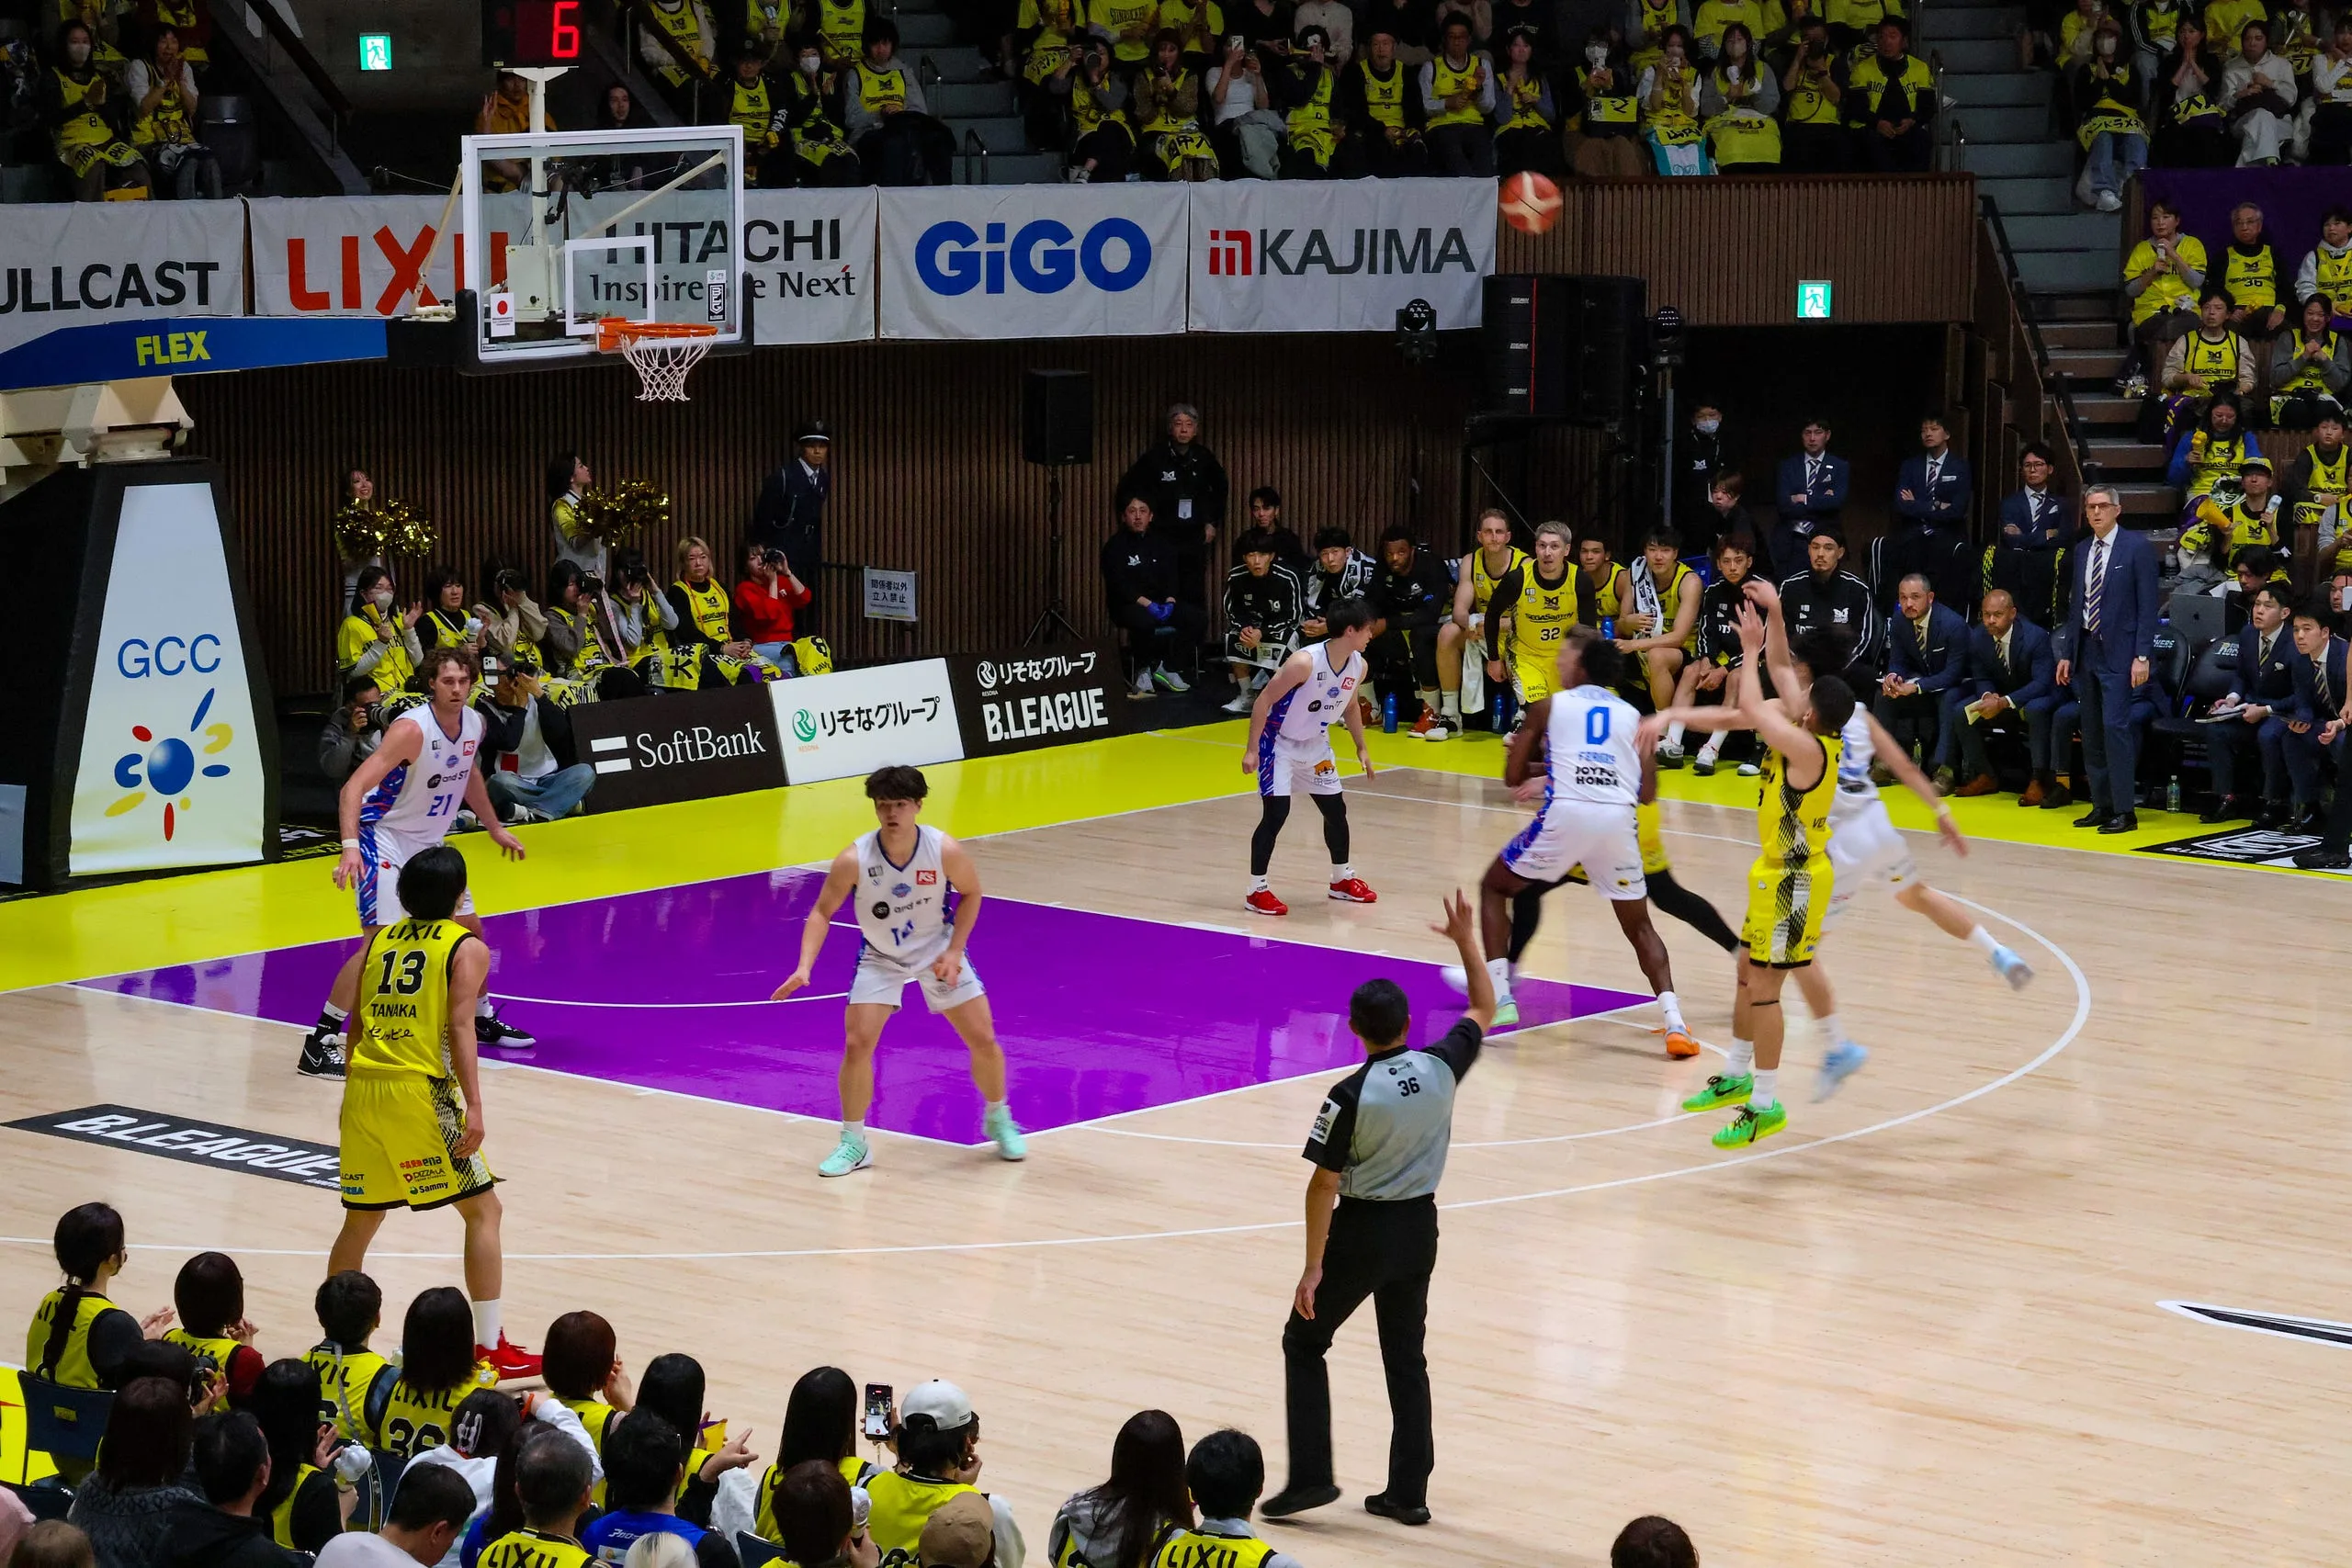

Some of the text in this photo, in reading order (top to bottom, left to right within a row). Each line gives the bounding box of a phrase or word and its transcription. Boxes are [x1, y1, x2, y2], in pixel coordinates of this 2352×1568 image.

[552, 1, 579, 58] 6
[605, 219, 840, 265] HITACHI
[915, 218, 1152, 296] GiGO
[1260, 228, 1476, 275] KAJIMA
[589, 273, 704, 309] Inspire
[776, 266, 856, 299] Next
[136, 331, 211, 367] FLEX
[873, 592, 906, 604] 立入禁止
[1540, 627, 1560, 641] 32
[118, 634, 221, 679] GCC
[1000, 651, 1097, 685] りそなグループ
[820, 695, 941, 737] りそなグループ
[982, 687, 1109, 742] B.LEAGUE
[1586, 706, 1610, 746] 0
[636, 722, 767, 769] SoftBank
[426, 794, 454, 817] 21
[387, 924, 443, 942] LIXIL
[377, 949, 427, 996] 13
[370, 1003, 417, 1019] TANAKA
[1397, 1077, 1420, 1097] 36
[52, 1114, 341, 1177] B.LEAGUE
[419, 1181, 449, 1194] Sammy
